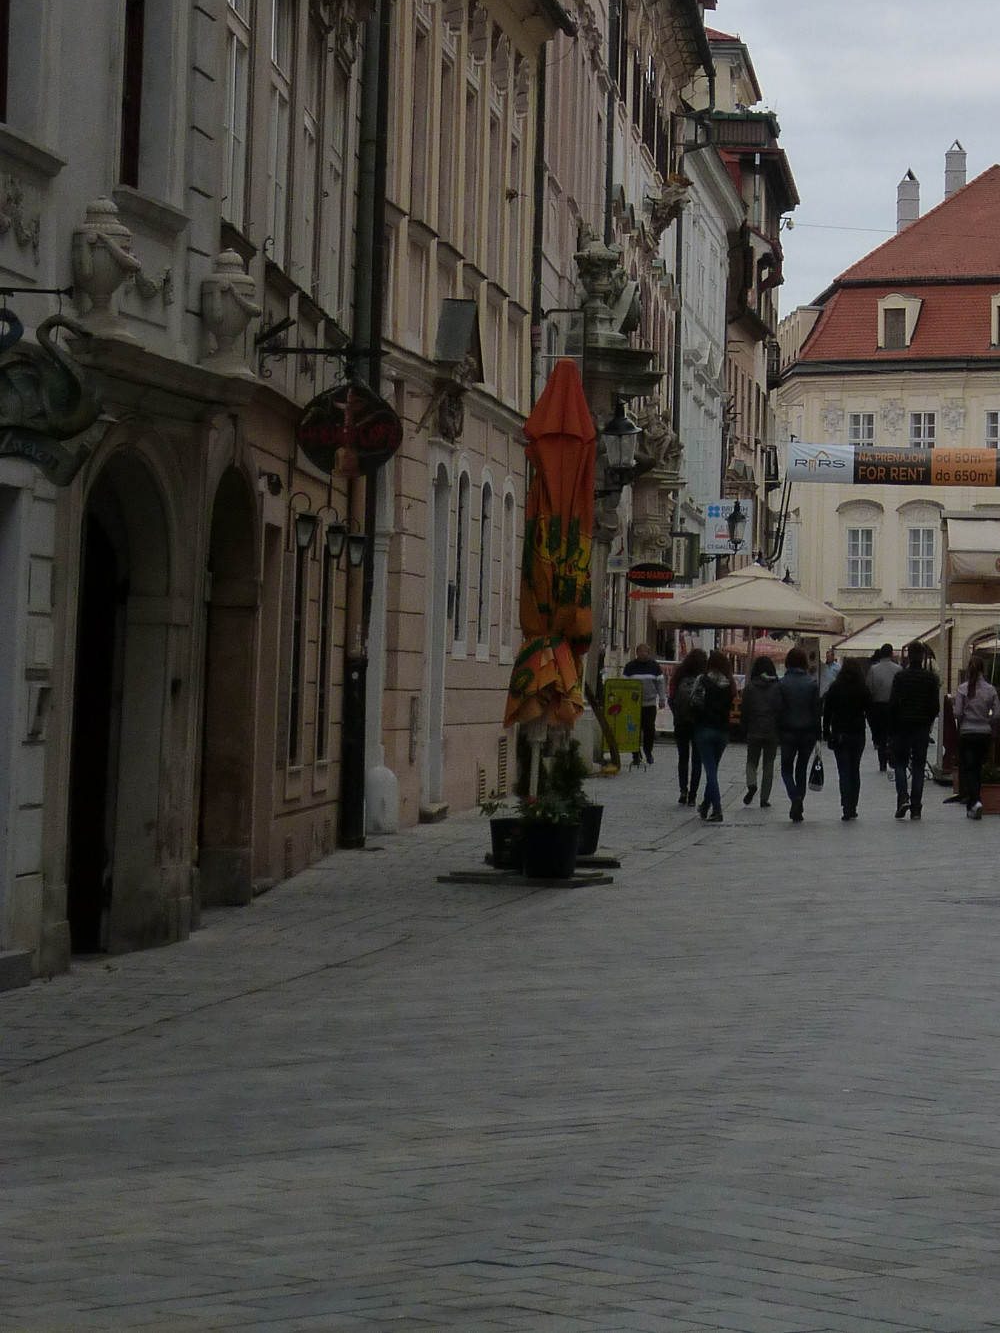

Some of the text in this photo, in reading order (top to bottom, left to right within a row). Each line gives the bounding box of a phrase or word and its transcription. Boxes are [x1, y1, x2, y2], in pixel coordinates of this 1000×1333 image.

[858, 451, 926, 463] NA PRENÁJOM
[936, 452, 951, 463] od
[858, 466, 926, 482] FOR RENT
[935, 470, 951, 481] do
